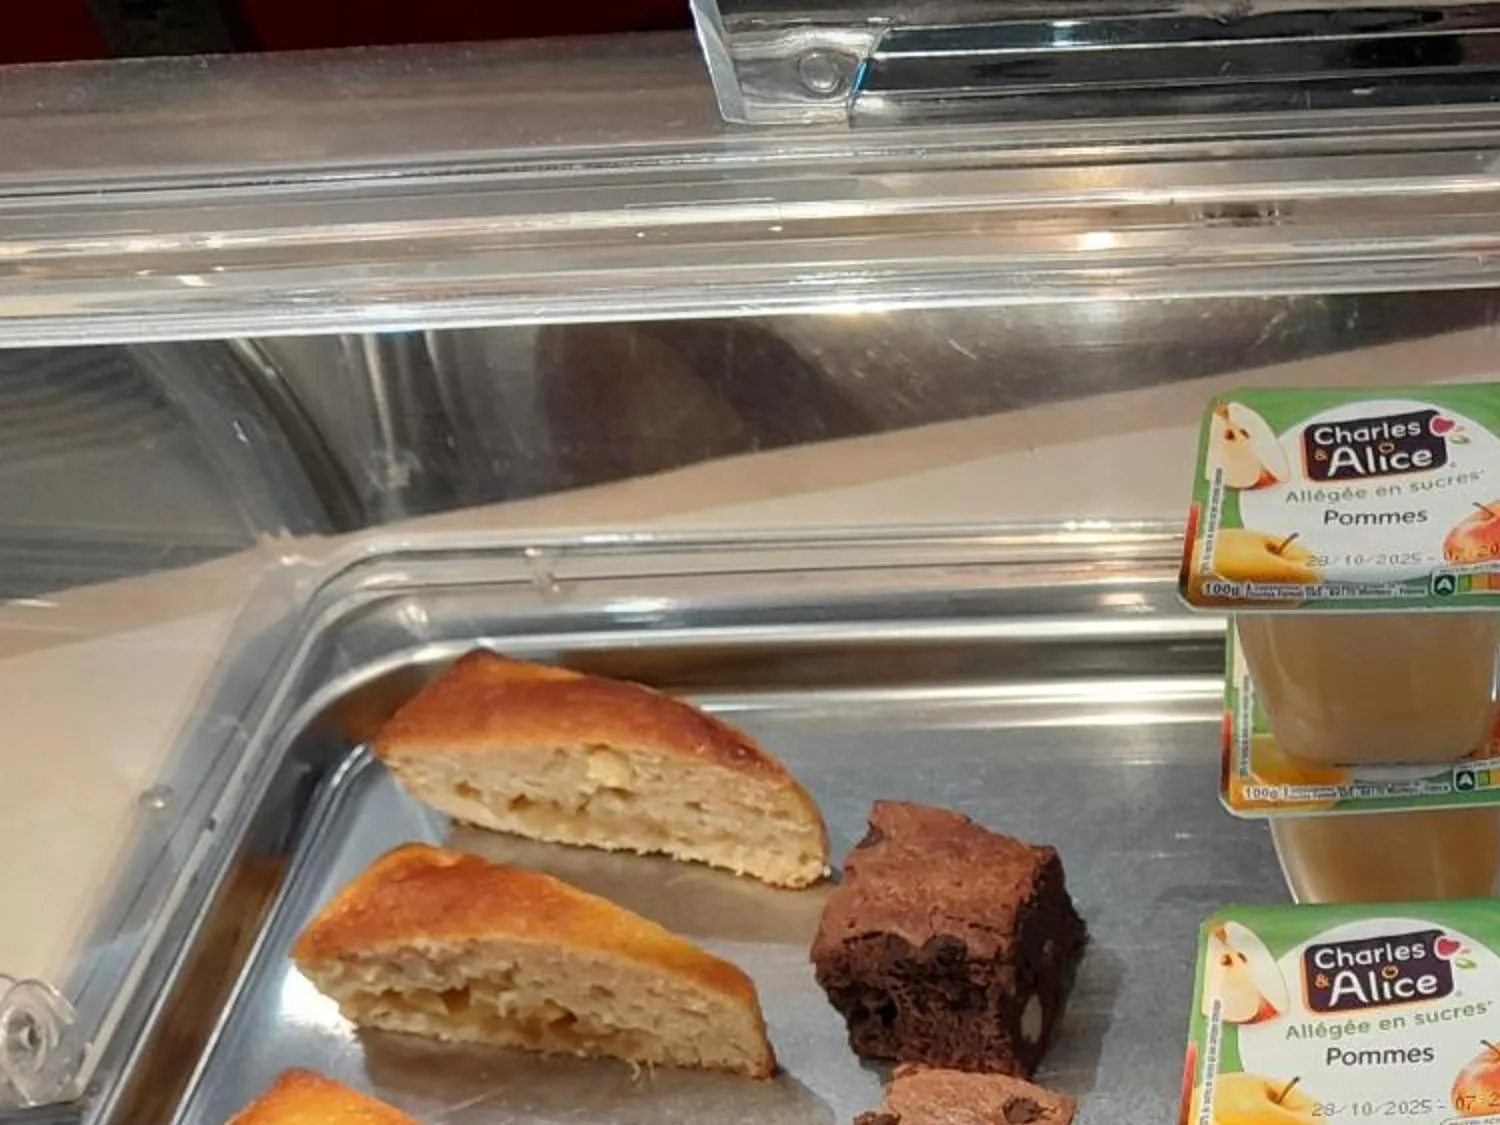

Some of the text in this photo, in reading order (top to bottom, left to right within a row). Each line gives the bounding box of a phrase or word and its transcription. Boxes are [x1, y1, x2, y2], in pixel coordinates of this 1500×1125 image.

[1314, 421, 1421, 445] Charles
[1327, 446, 1433, 477] Alice
[1286, 487, 1367, 505] Allégée
[1375, 485, 1402, 497] en
[1324, 509, 1428, 525] Pommes
[1314, 942, 1426, 970] Charles
[1315, 970, 1438, 1007] & Alice
[1285, 1019, 1371, 1041] Allégée
[1379, 1017, 1406, 1031] en
[1326, 1047, 1435, 1066] Pommes
